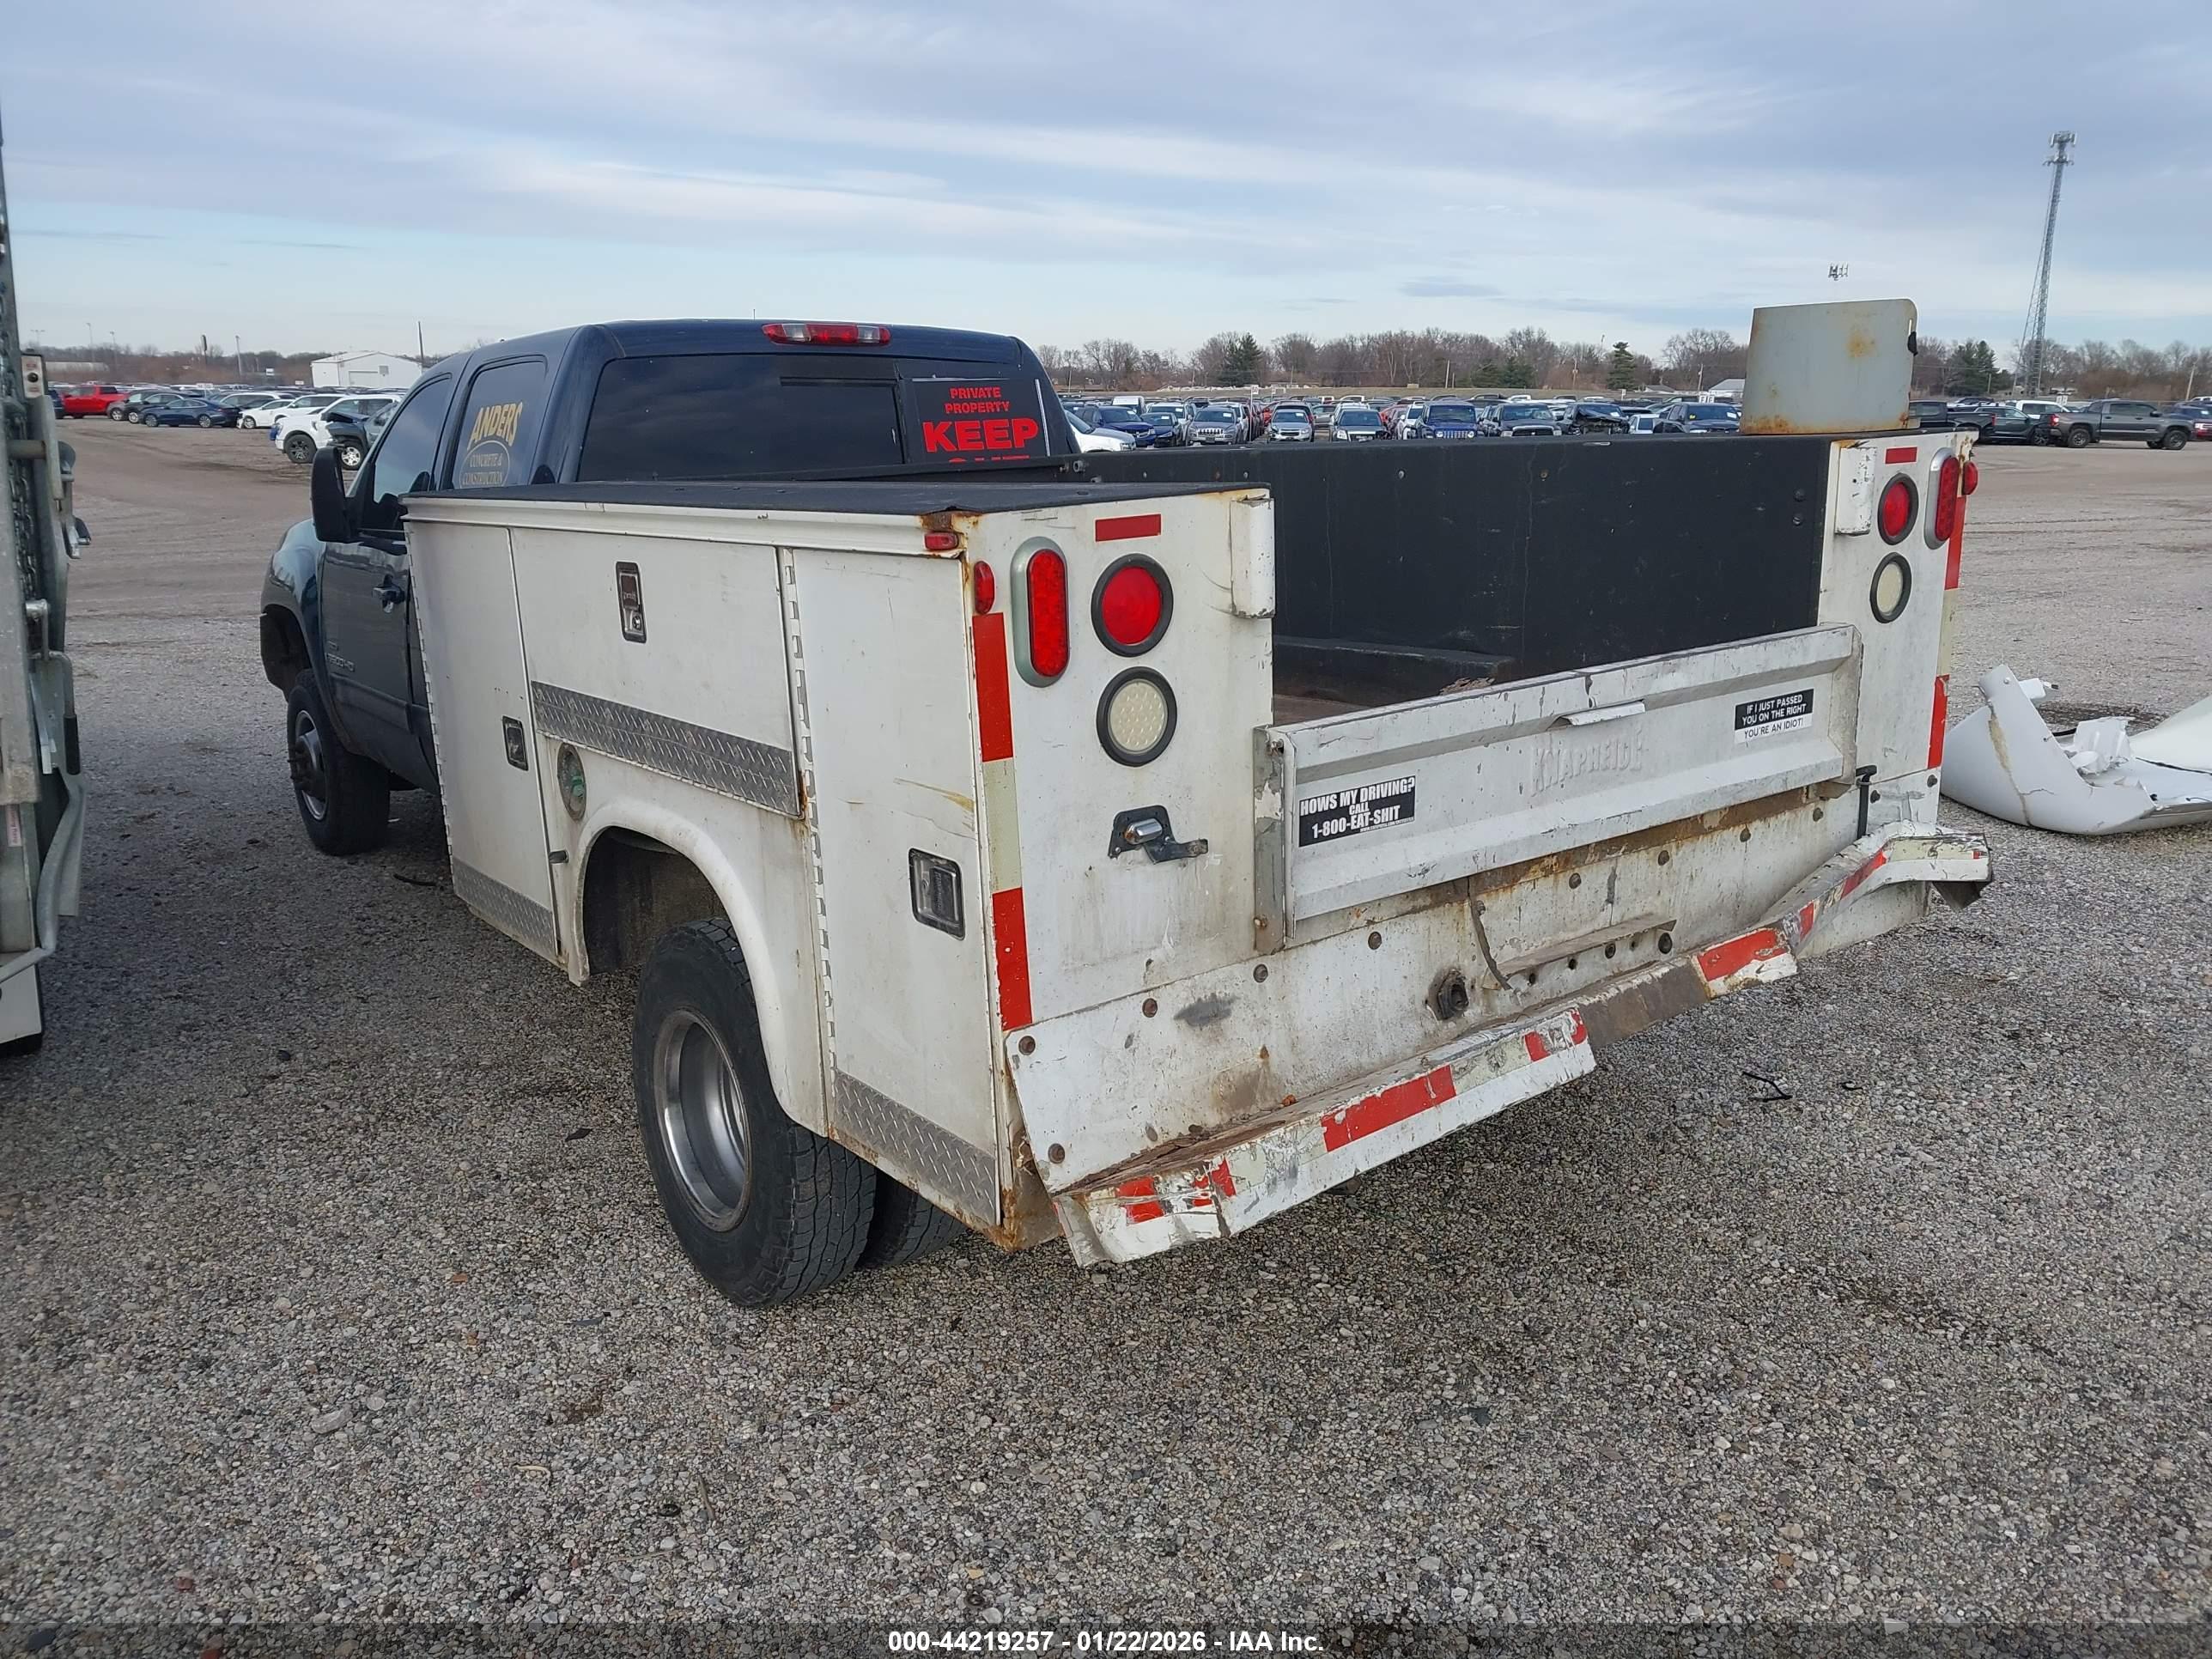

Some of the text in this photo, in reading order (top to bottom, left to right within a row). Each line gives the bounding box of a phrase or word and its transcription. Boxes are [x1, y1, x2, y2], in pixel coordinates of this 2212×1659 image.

[950, 386, 1001, 398] PRIVATE
[944, 401, 1010, 414] PROPERTY
[466, 401, 523, 451] ANDERS
[922, 417, 1038, 453] KEEP
[1747, 704, 1753, 714] IF
[1759, 700, 1775, 713] JUST
[1777, 694, 1802, 708] PASSED
[1741, 704, 1807, 726] YOU ON THE RIGHT
[1744, 725, 1770, 738] YOU'RE
[1771, 721, 1782, 732] AN
[1300, 777, 1415, 816] HOWS MY DRIVING?
[1348, 801, 1370, 816] CALL
[1311, 805, 1401, 838] 1-800-EAT-SHIT
